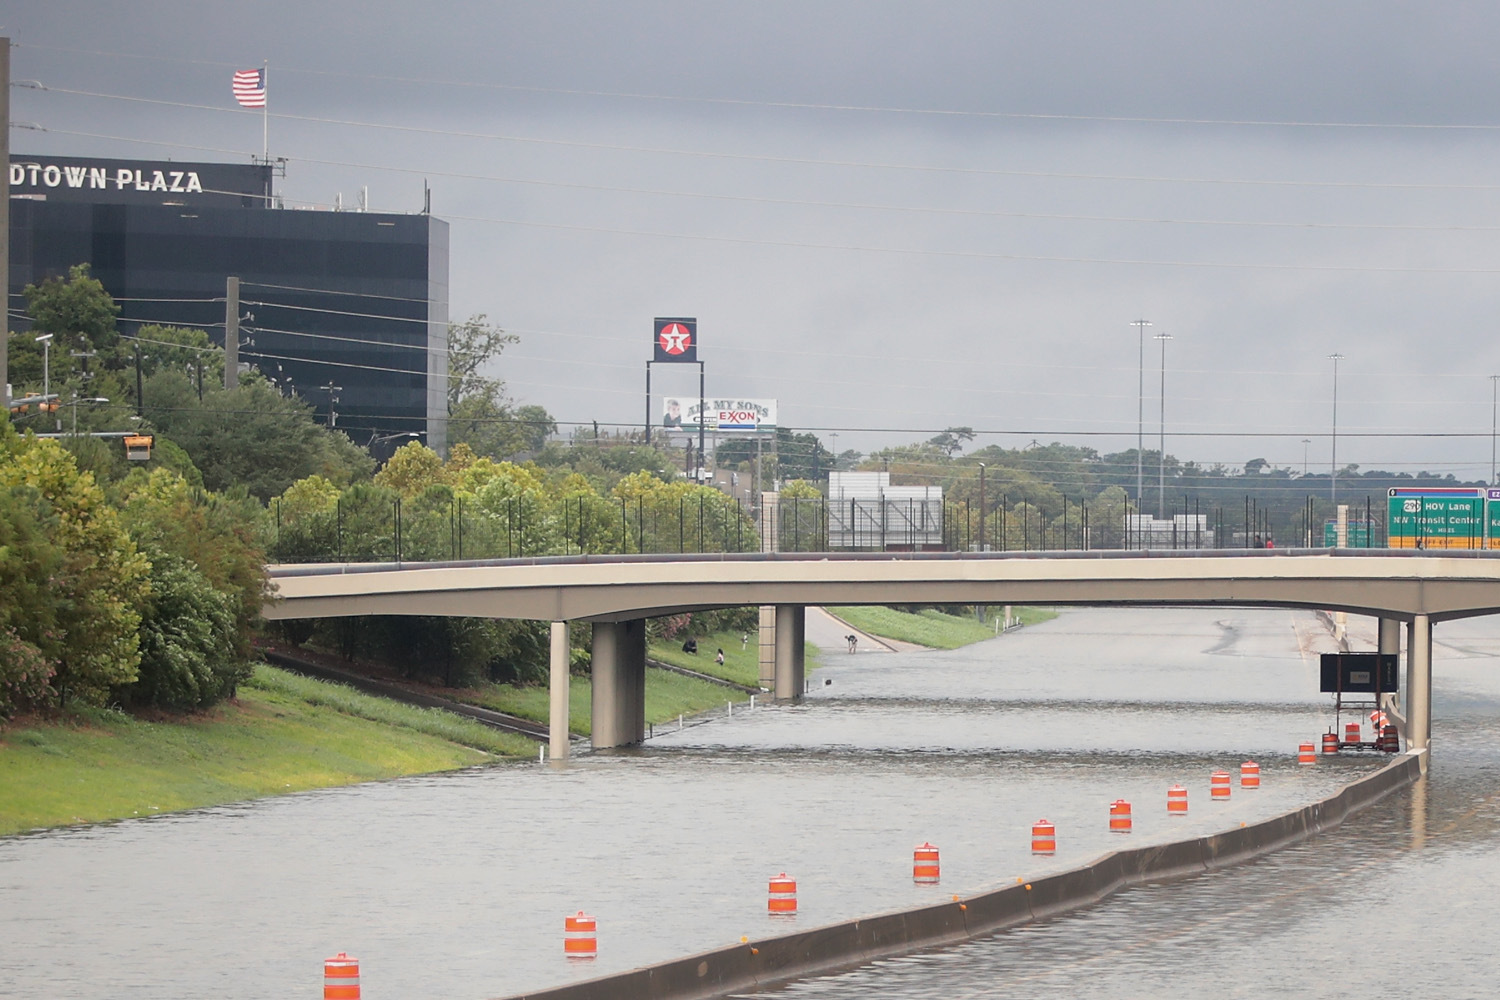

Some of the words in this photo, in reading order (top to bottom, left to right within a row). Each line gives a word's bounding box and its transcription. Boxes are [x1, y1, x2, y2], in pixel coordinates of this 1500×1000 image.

[115, 168, 203, 193] PLAZA
[714, 400, 735, 410] MY
[737, 401, 769, 418] SONS
[719, 411, 755, 424] EXXON
[1425, 503, 1445, 511] HOV
[1449, 503, 1471, 511] Lane
